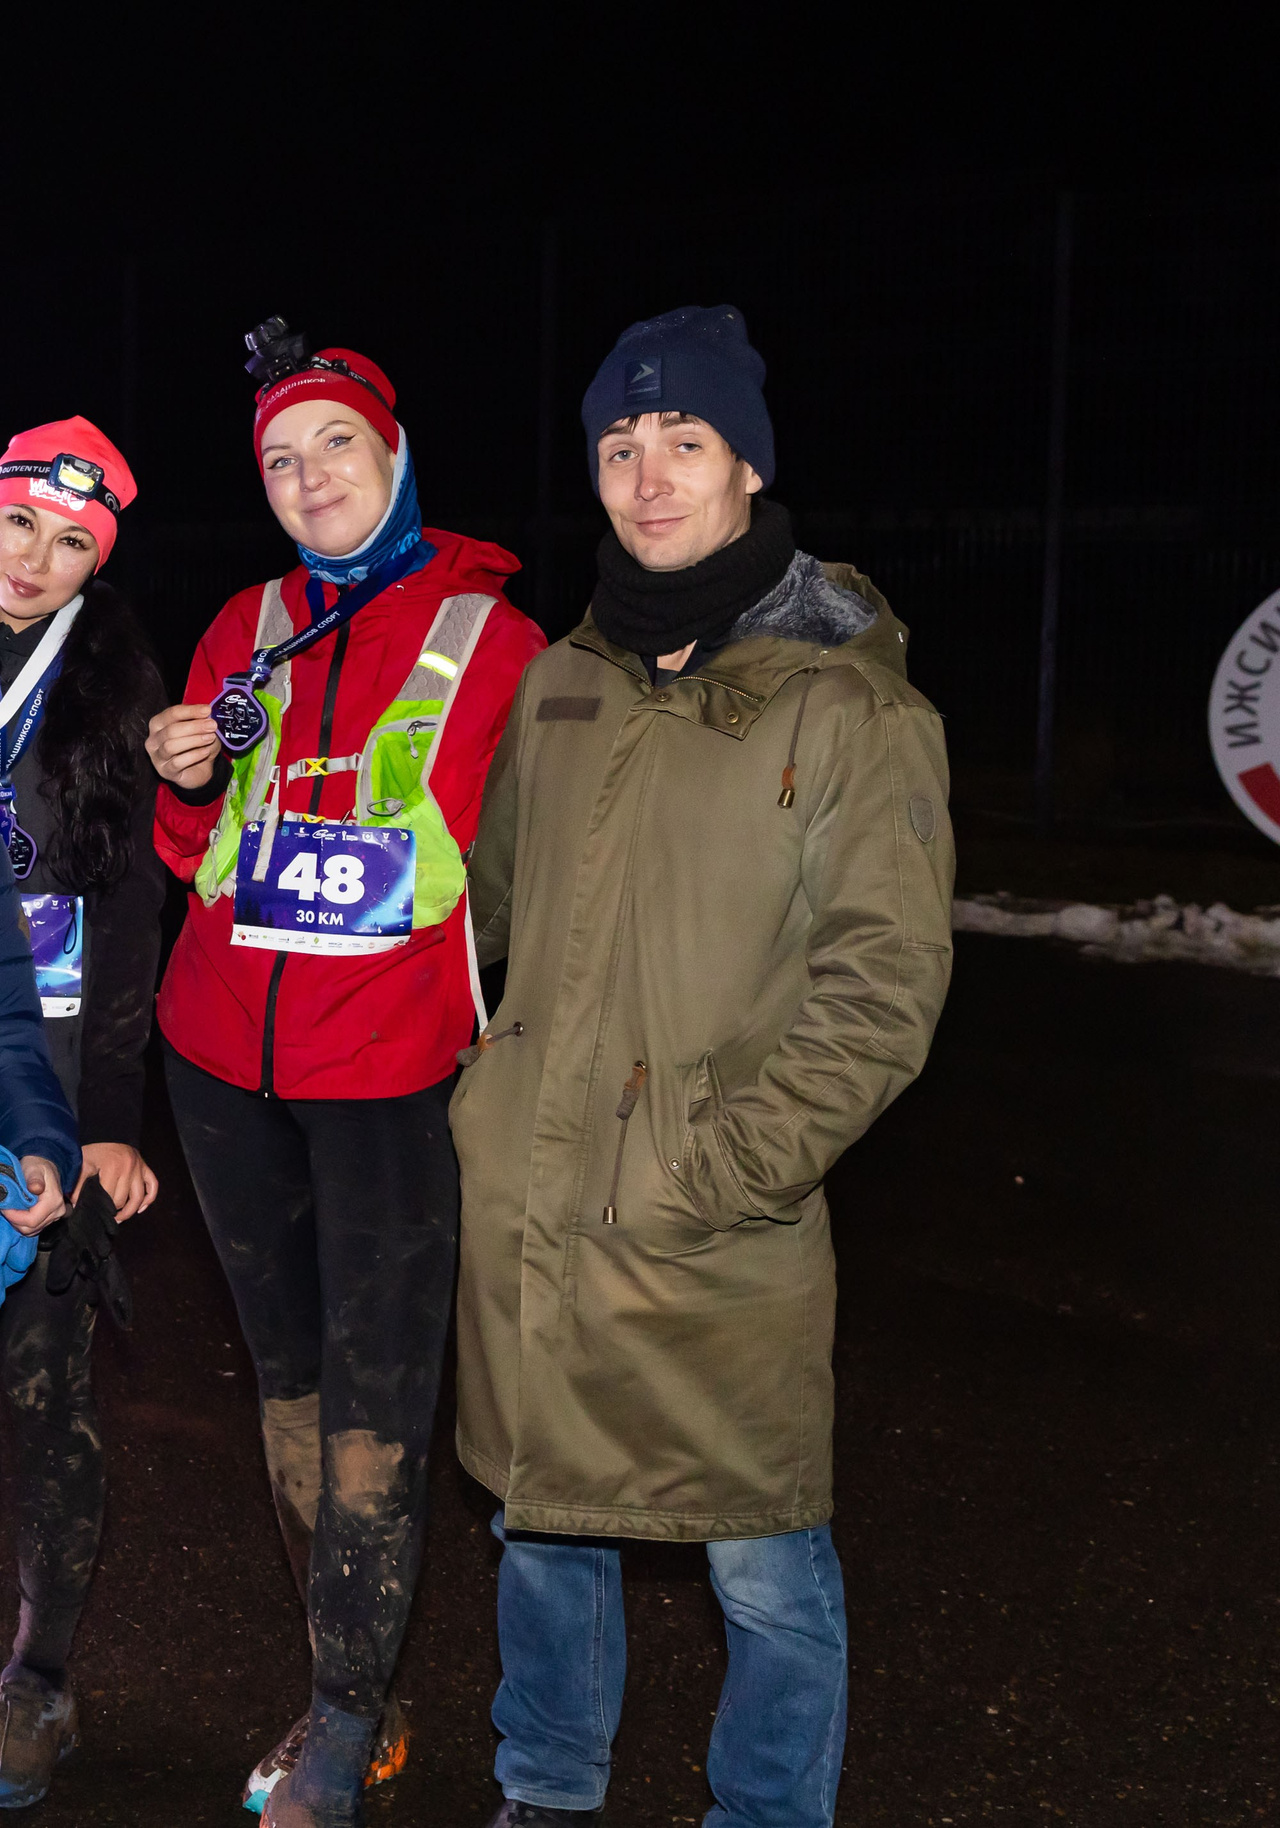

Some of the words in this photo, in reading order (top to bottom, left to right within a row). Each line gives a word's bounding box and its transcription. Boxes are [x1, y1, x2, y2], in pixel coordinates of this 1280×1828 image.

[317, 610, 341, 629] СПОРТ
[1224, 605, 1280, 748] ИЖСИ
[29, 688, 45, 717] СПОРТ
[278, 852, 365, 905] 48
[296, 909, 315, 924] 30
